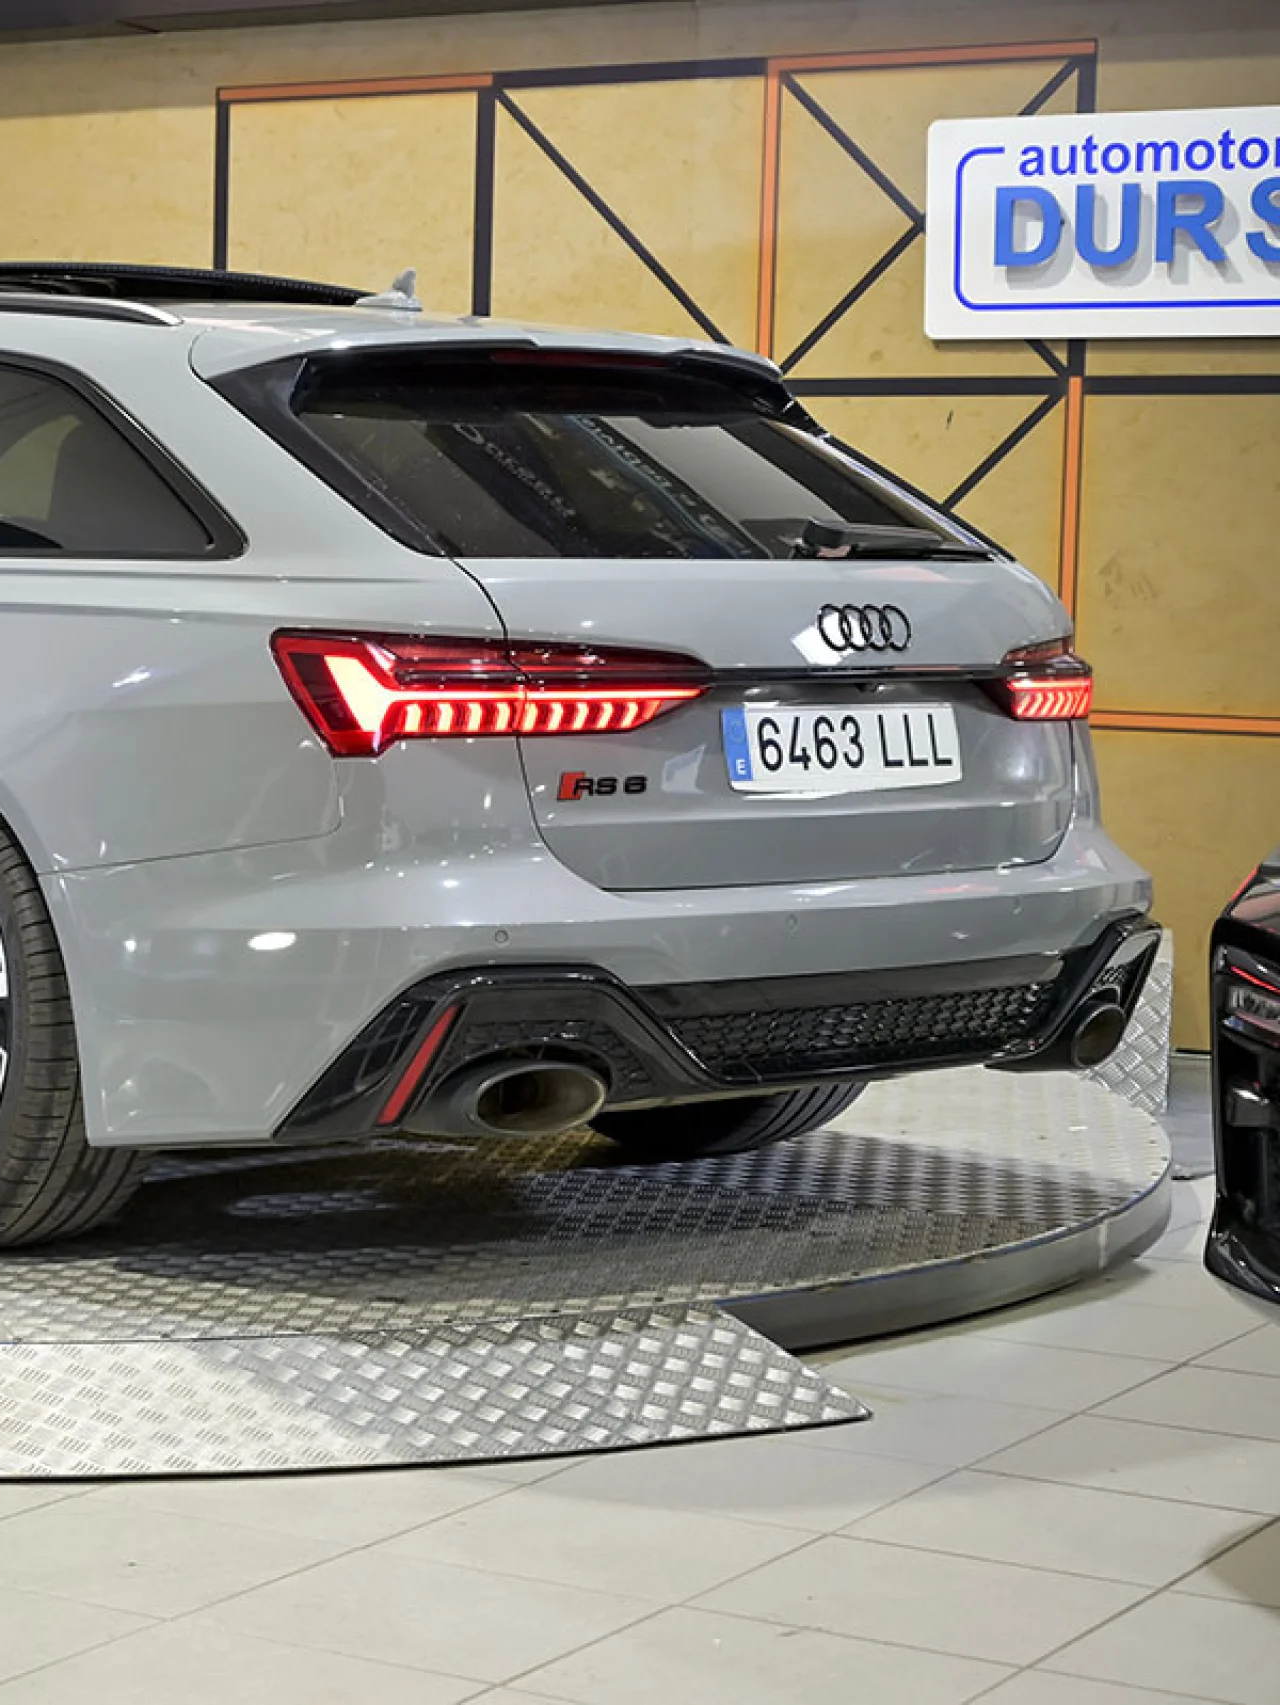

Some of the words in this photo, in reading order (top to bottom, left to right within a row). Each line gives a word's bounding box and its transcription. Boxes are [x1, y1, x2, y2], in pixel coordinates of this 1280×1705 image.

[756, 714, 865, 772] 6463
[877, 713, 953, 768] LLL
[734, 758, 748, 776] E
